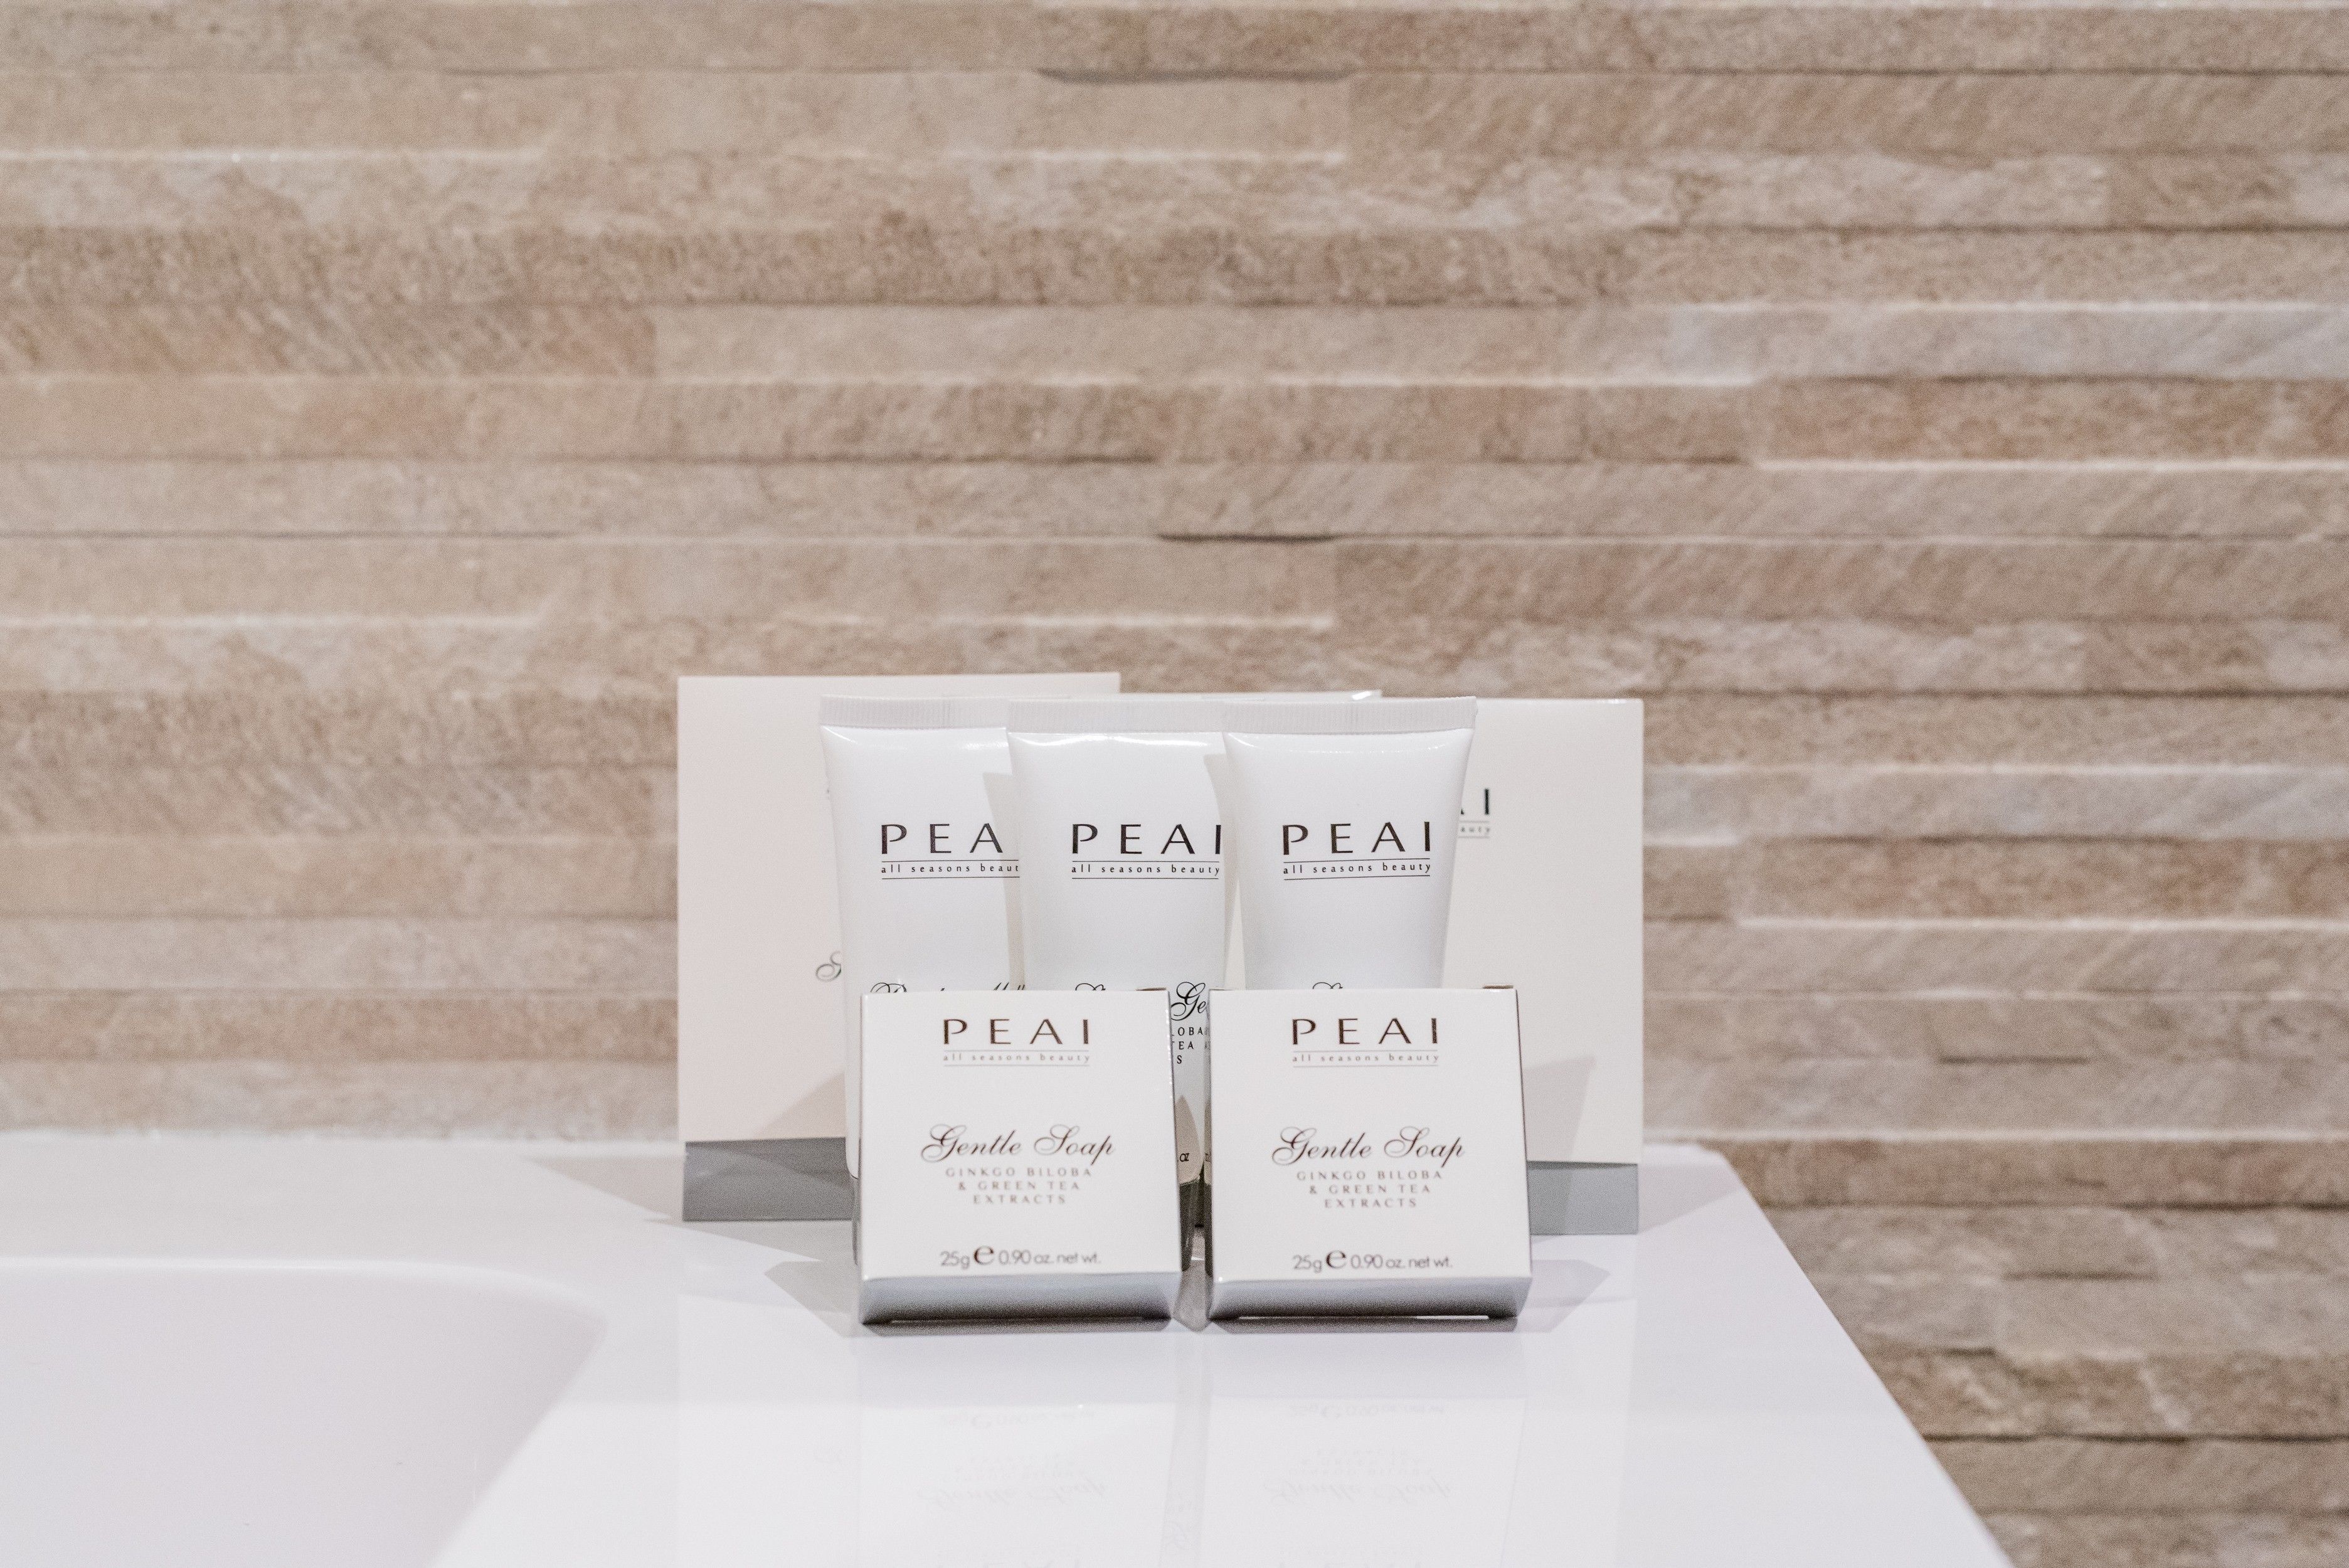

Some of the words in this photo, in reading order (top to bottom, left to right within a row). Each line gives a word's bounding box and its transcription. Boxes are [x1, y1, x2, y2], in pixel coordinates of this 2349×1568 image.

[1460, 826, 1491, 836] auty
[880, 822, 1004, 856] PEA
[1071, 823, 1222, 856] PEAI
[1282, 821, 1431, 856] PEAI
[880, 864, 901, 874] all
[980, 862, 1020, 873] beaut
[1071, 863, 1091, 874] all
[1170, 863, 1220, 876] beauty
[1282, 864, 1303, 875] all
[1312, 864, 1373, 874] seasons
[1382, 862, 1431, 873] beauty
[1170, 982, 1207, 1021] Ge
[943, 1018, 1090, 1046] PEAI
[1172, 1027, 1204, 1037] OBA
[1291, 1017, 1438, 1046] PEAI
[1172, 1041, 1194, 1051] EA
[942, 1052, 962, 1062] all
[1039, 1052, 1090, 1064] beauty
[1291, 1052, 1312, 1063] all
[1388, 1052, 1440, 1064] beauty
[920, 1123, 1022, 1163] Gentle
[1033, 1123, 1115, 1165] Soap
[1271, 1126, 1372, 1167] Gentle
[1383, 1126, 1465, 1168] Soap
[945, 1167, 1016, 1178] GINKGO
[1026, 1167, 1092, 1178] BILOBA
[1296, 1170, 1367, 1182] GINKGO
[1377, 1169, 1443, 1180] BILOBA
[957, 1180, 967, 1192] &
[977, 1180, 1036, 1191] GREEN
[1047, 1180, 1080, 1191] TEA
[1308, 1184, 1318, 1195] &
[1328, 1184, 1387, 1195] GREEN
[1397, 1184, 1431, 1194] TEA
[972, 1194, 1066, 1205] EXTRACTS
[1323, 1197, 1417, 1209] EXTRACTS
[940, 1251, 970, 1270] 25g
[997, 1249, 1032, 1266] 0.90
[1056, 1251, 1079, 1265] net
[1291, 1254, 1323, 1274] 25g
[1349, 1253, 1384, 1270] 0.90
[1408, 1256, 1431, 1269] net
